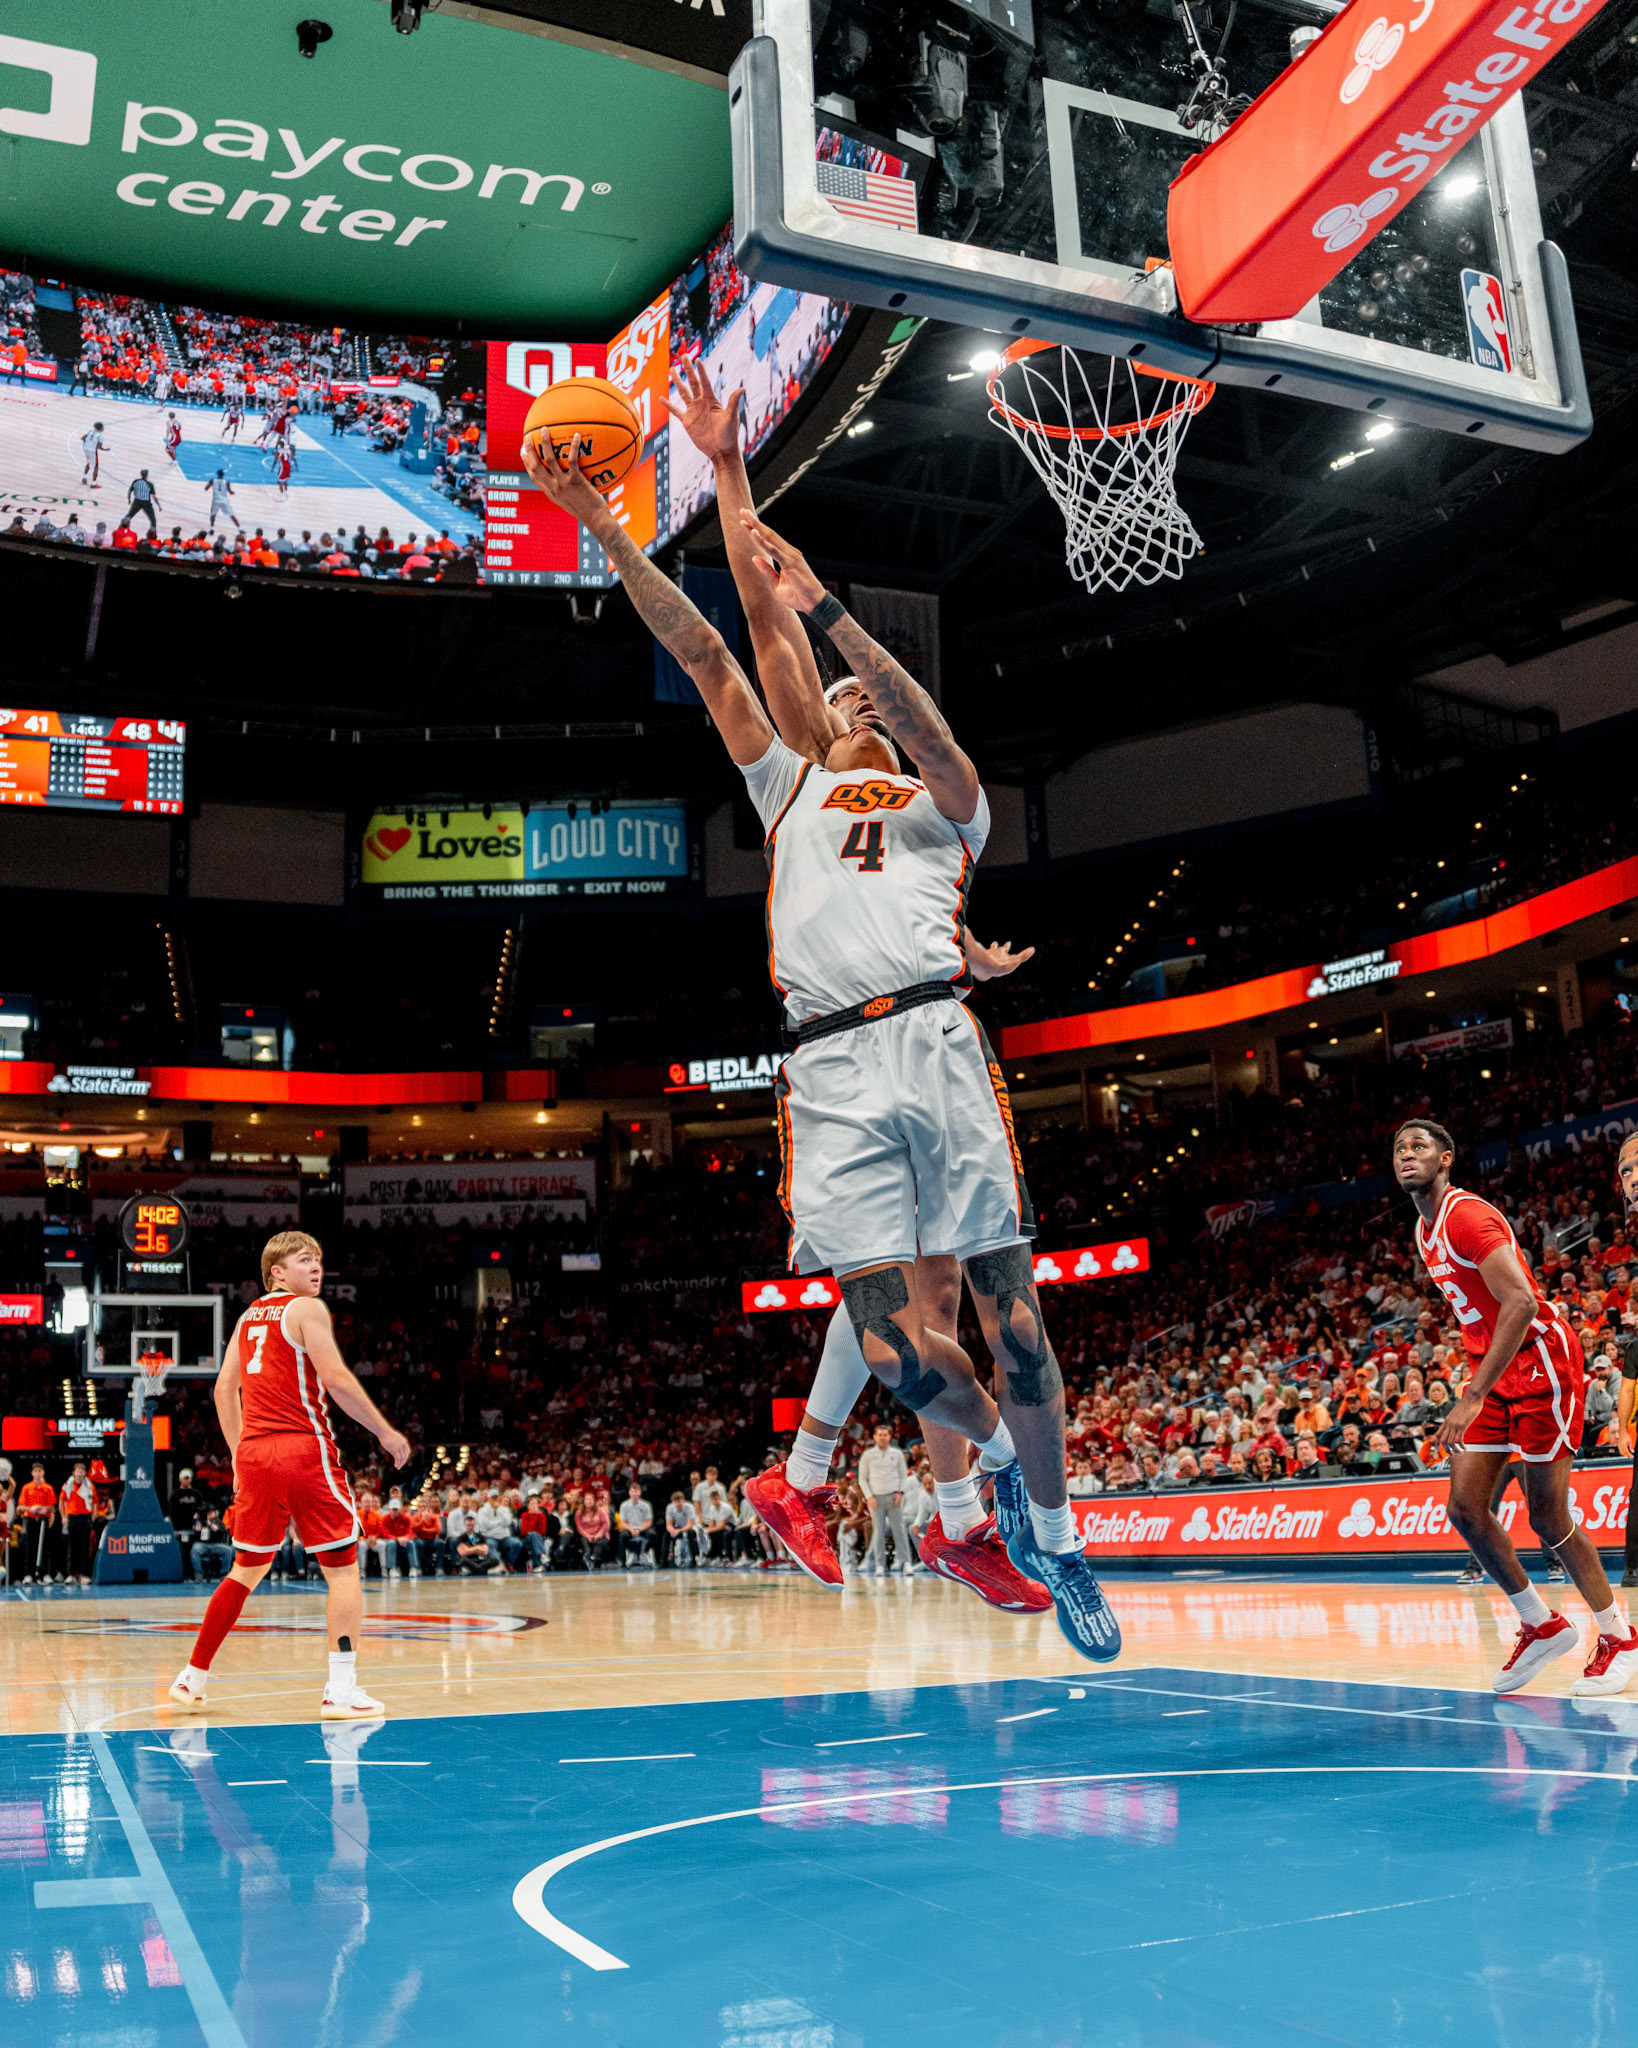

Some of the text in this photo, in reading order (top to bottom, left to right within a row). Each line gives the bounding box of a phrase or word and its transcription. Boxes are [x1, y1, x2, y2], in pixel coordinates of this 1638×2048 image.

[116, 172, 448, 247] center
[1478, 346, 1499, 367] NBA
[489, 475, 520, 486] PLAYER
[487, 490, 519, 502] BROWN
[487, 507, 517, 518] WAGUE
[487, 522, 530, 535] FORSYTHE
[487, 539, 513, 550] JONES
[487, 555, 512, 566] DAVIS
[533, 573, 540, 584] 2
[554, 574, 571, 584] 2ND
[580, 575, 603, 586] 14:03
[24, 715, 48, 733] 41
[70, 723, 103, 737] 14:03
[122, 722, 151, 740] 48
[820, 779, 919, 814] OSU
[532, 817, 680, 870] LOUD CITY
[840, 821, 885, 872] 4
[384, 880, 667, 899] BRING THE THUNDER EXIT NOW
[1322, 949, 1386, 976] PRESENTED BY
[1327, 961, 1402, 993] StateFarm
[864, 997, 894, 1018] OSU
[67, 1065, 135, 1079] PRESENTED BY
[70, 1076, 151, 1095] StateFarm
[710, 1077, 774, 1093] BASKETBALL
[370, 1176, 578, 1199] POST OAK PARTY TERRACE
[137, 1205, 180, 1226] 14:02
[134, 1221, 170, 1254] 3.6
[246, 1325, 268, 1375] 7
[57, 1419, 115, 1432] BEDLAM
[1079, 1510, 1172, 1543] StateFarm
[1210, 1504, 1326, 1541] StateFarm
[128, 1544, 154, 1553] BANK
